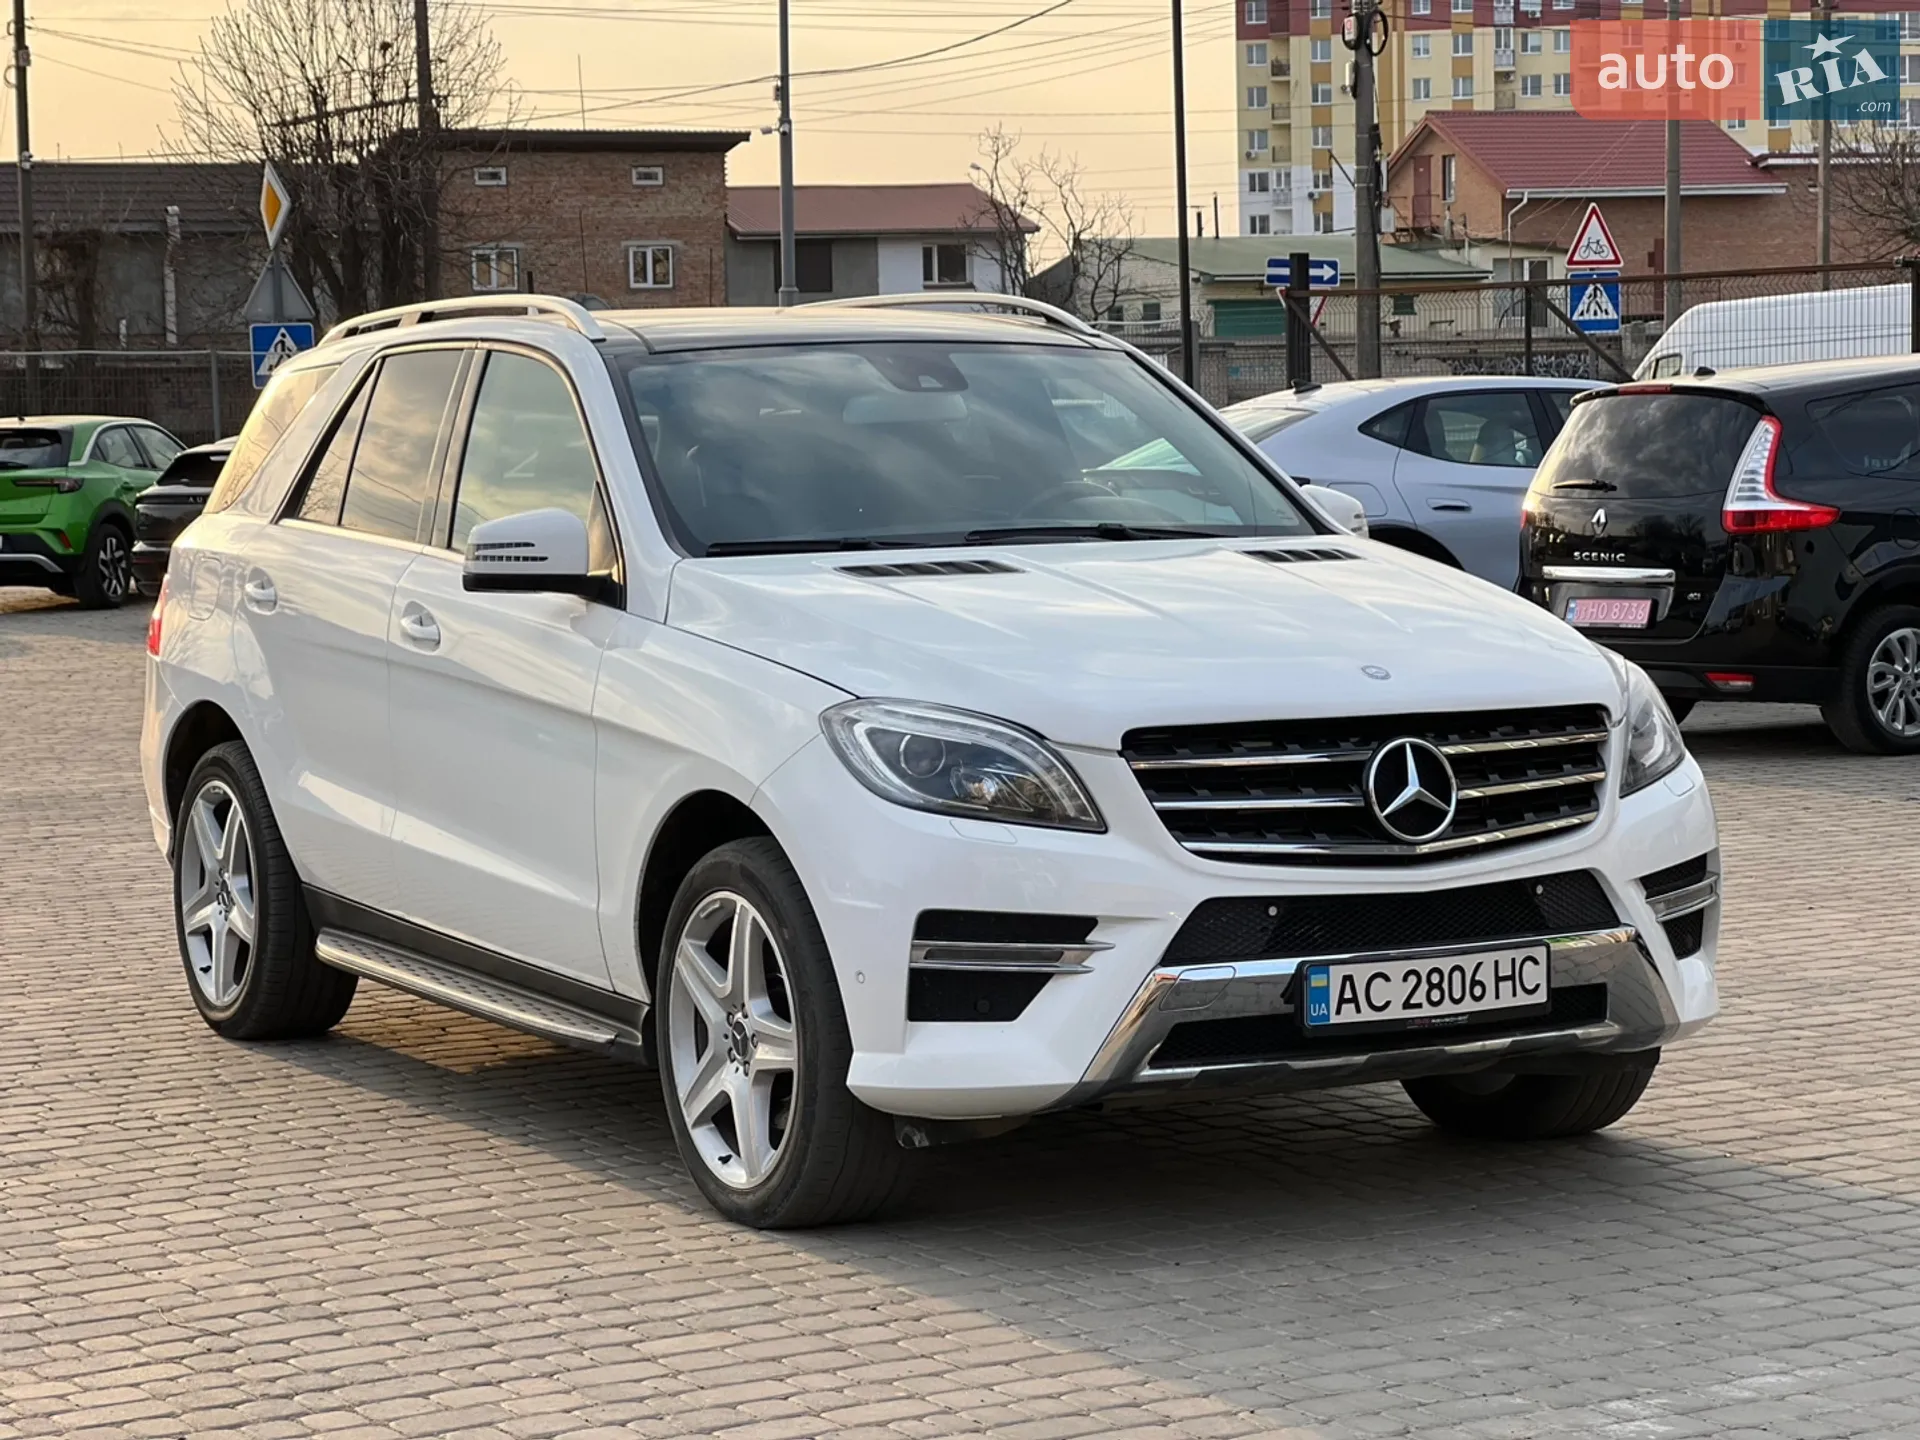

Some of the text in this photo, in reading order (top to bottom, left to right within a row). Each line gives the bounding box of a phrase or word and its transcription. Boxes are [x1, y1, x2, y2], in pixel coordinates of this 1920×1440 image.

[1573, 551, 1626, 562] SCENIC
[1335, 955, 1541, 1016] AC 2806 HC
[1310, 1003, 1329, 1017] UA
